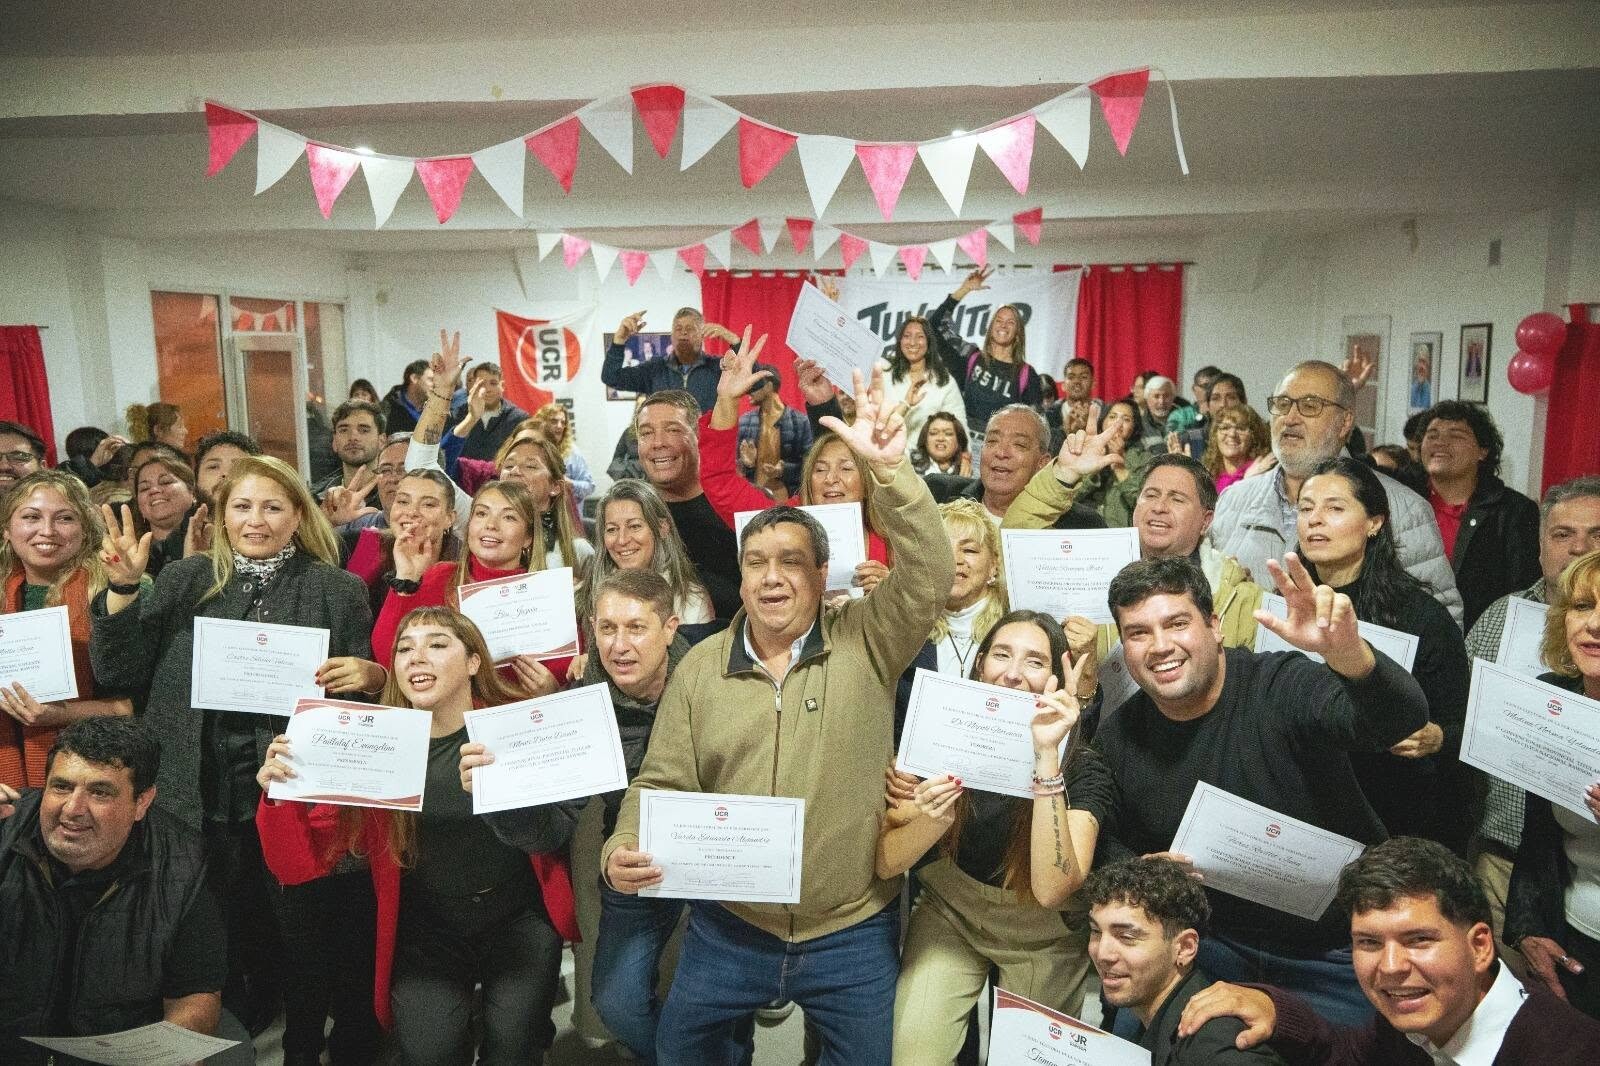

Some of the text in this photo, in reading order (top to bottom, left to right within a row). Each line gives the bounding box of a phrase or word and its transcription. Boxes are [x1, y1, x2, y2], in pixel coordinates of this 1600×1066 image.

[538, 328, 562, 382] UCR
[985, 701, 1000, 709] UCR
[1547, 702, 1562, 712] UCR
[1265, 826, 1281, 836] UCR
[1048, 1025, 1062, 1036] UCR
